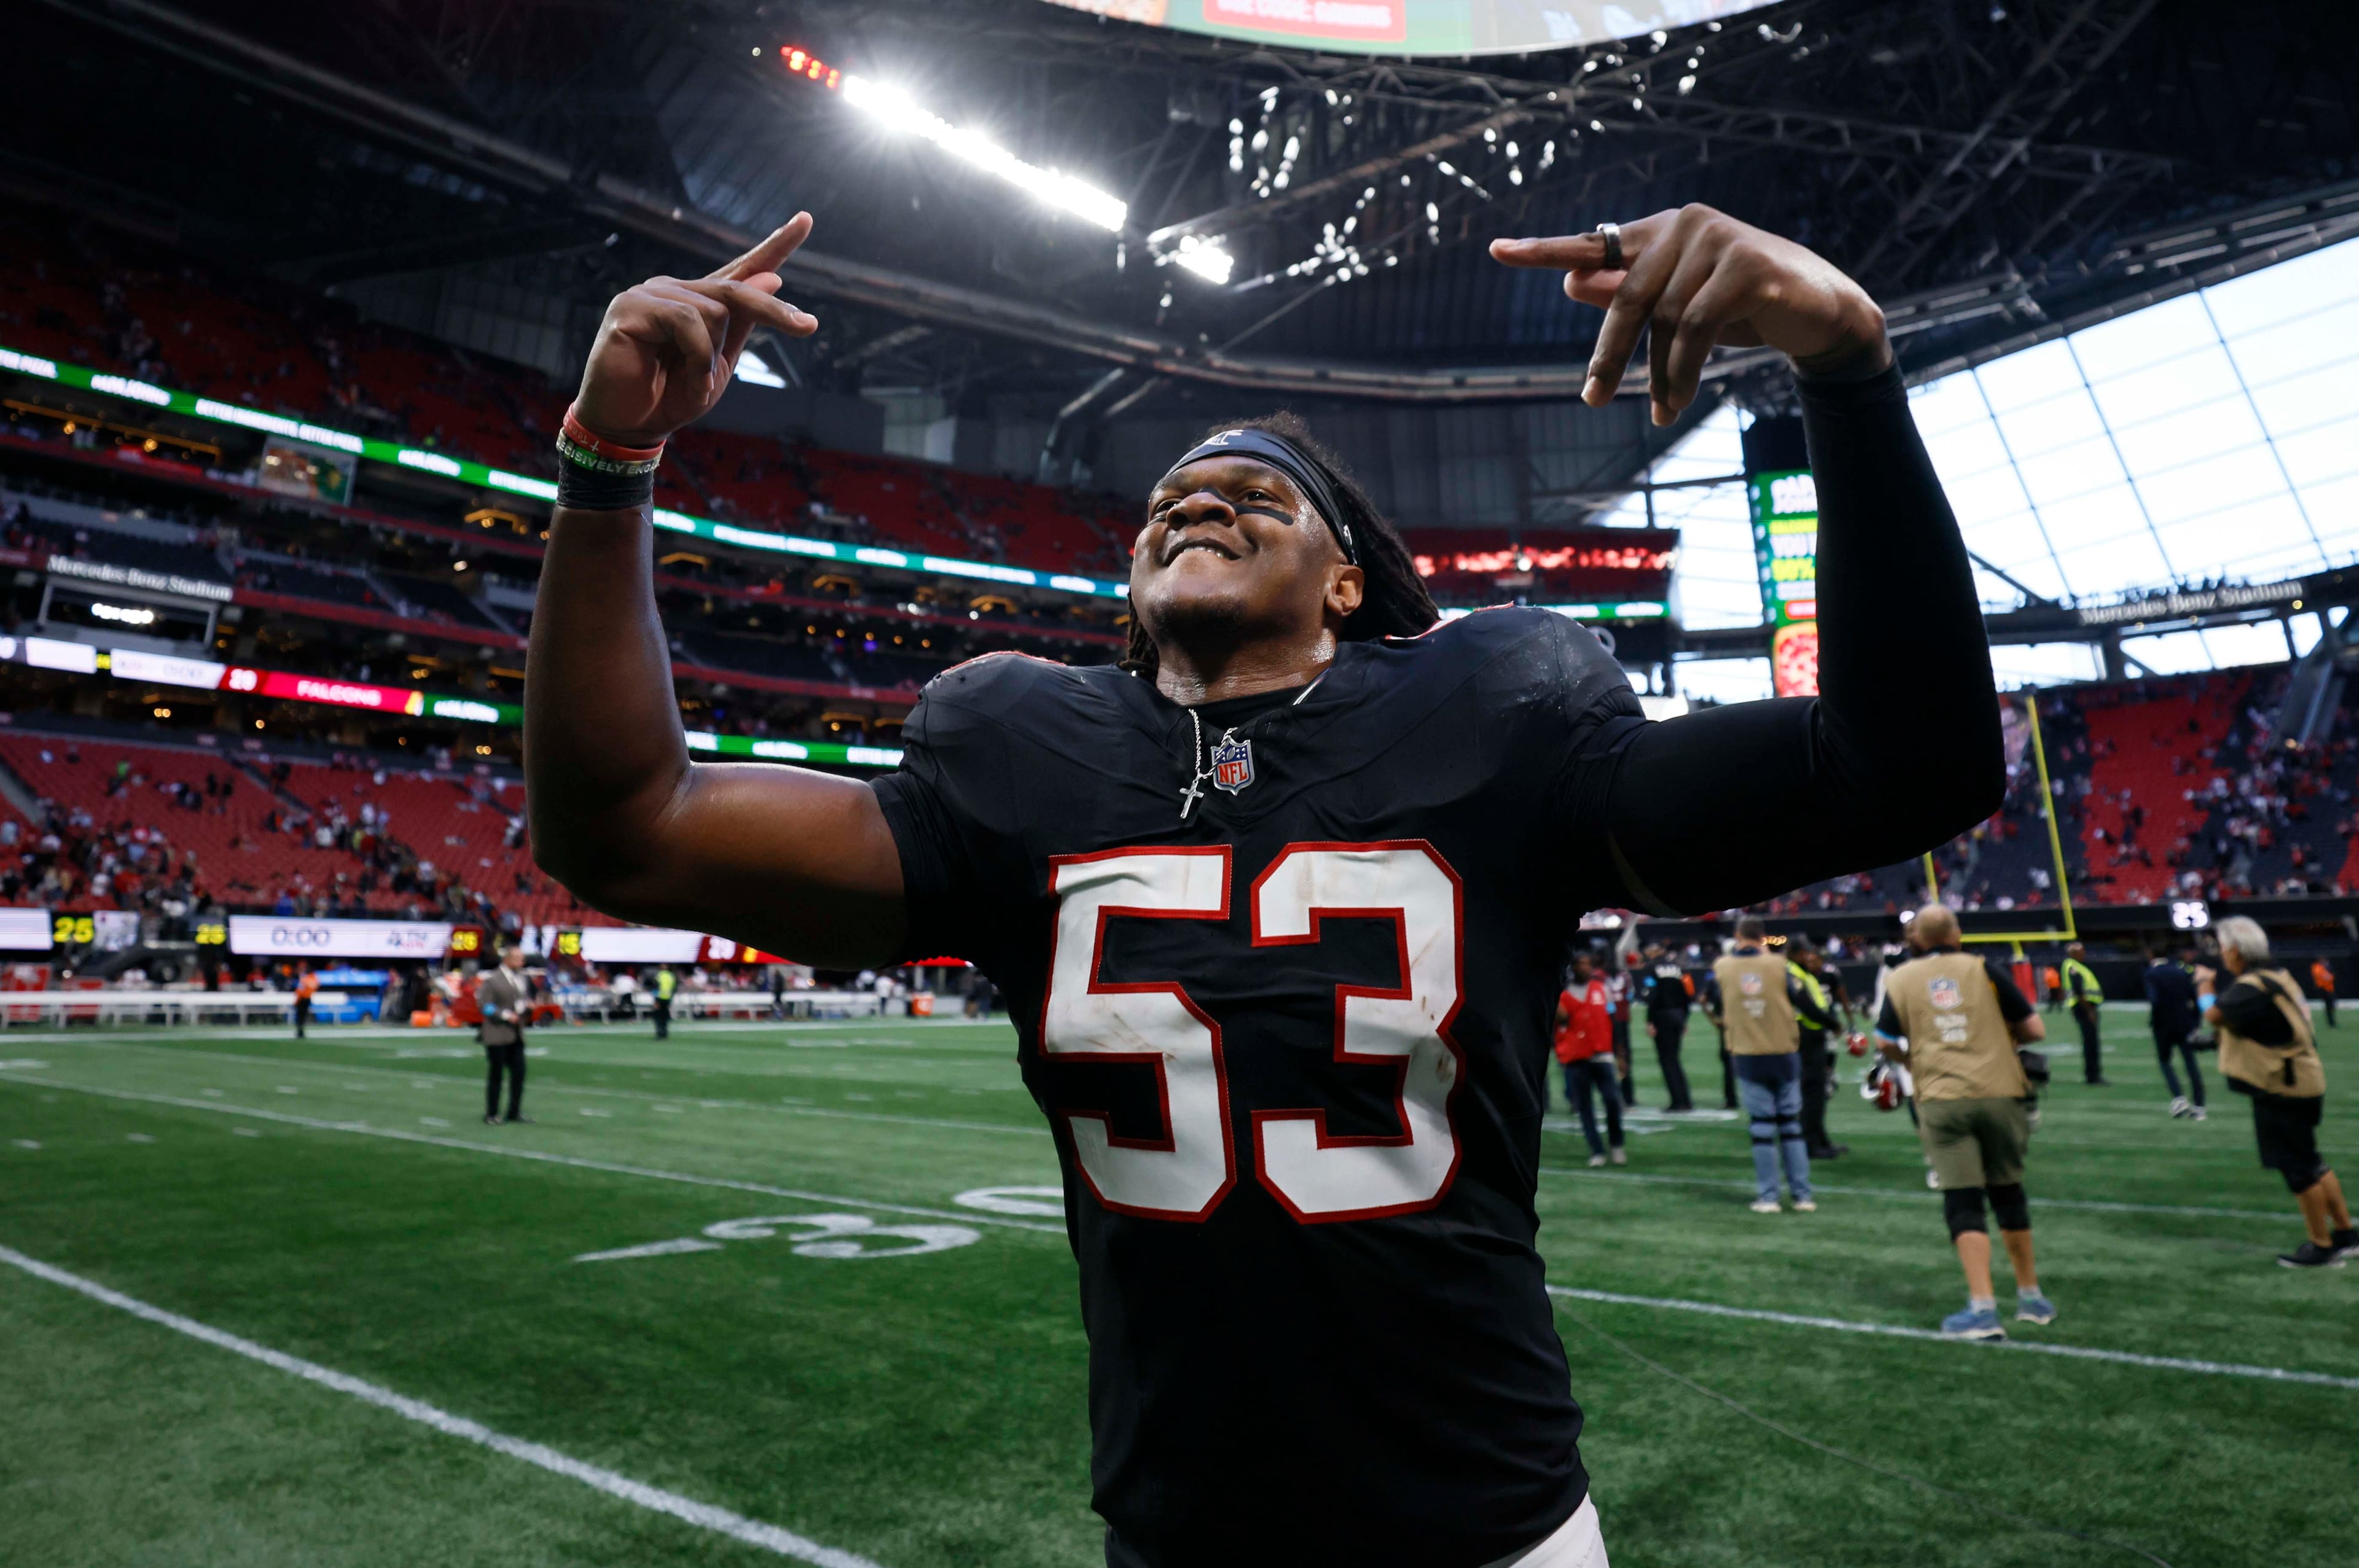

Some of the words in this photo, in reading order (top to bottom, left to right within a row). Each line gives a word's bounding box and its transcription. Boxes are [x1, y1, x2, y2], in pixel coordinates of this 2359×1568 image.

[297, 680, 381, 707] FALCONS
[1218, 762, 1248, 784] NFL
[53, 916, 94, 943] 25
[272, 926, 331, 947] 0:00
[1038, 838, 1466, 1225] 53
